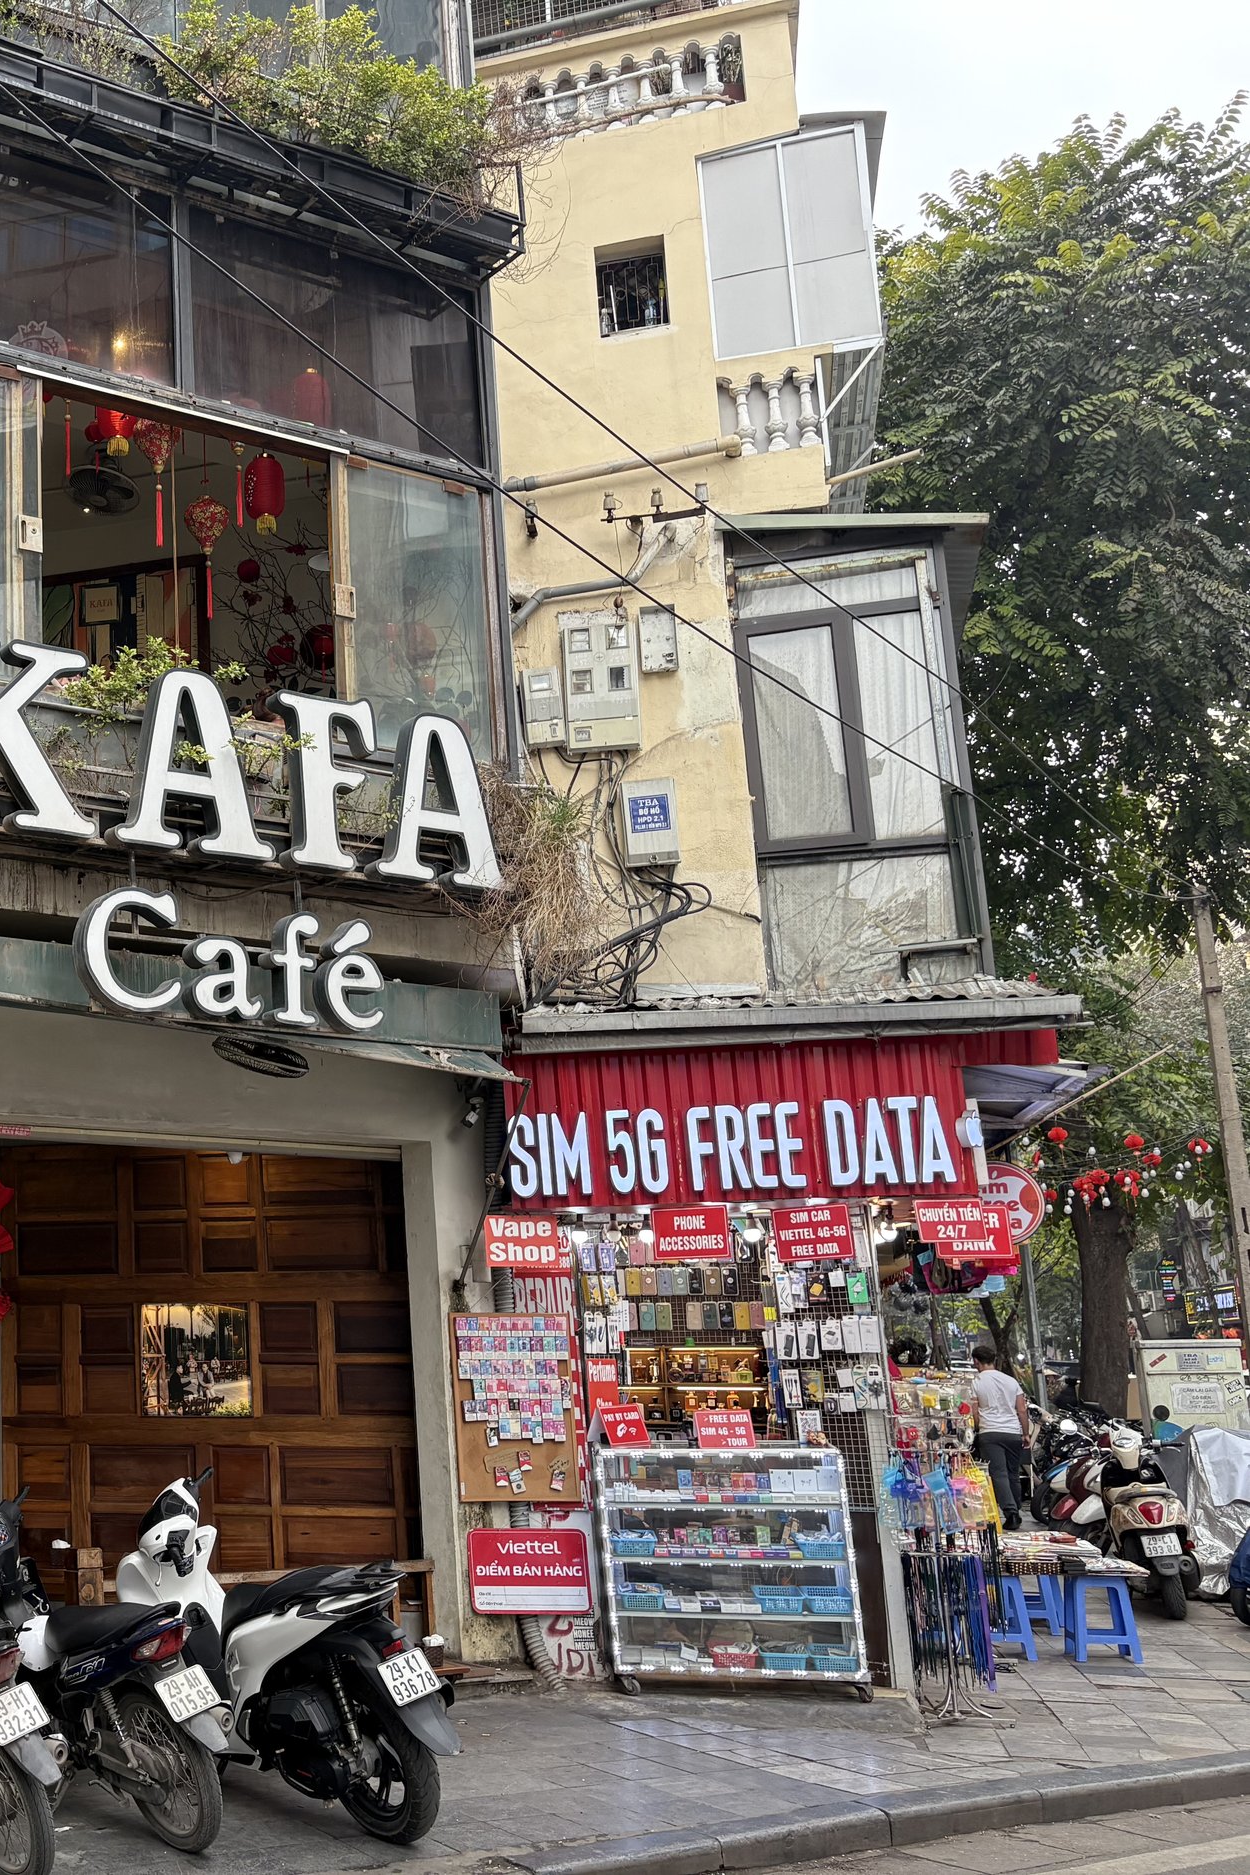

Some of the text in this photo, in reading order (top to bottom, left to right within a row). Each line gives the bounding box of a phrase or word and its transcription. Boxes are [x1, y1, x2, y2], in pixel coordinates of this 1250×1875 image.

[638, 799, 659, 807] TBA
[72, 887, 384, 1032] Café
[507, 1095, 958, 1199] SIM 5G FREE DATA
[979, 1181, 1008, 1194] im
[790, 1210, 831, 1224] SIM CAR
[919, 1203, 956, 1222] CHUYỂN
[489, 1218, 552, 1239] Vape
[674, 1215, 706, 1231] PHONE
[779, 1225, 847, 1241] VIETTEL 4G-5G
[937, 1225, 966, 1239] 24/7
[659, 1235, 725, 1252] ACCESSORIES
[791, 1243, 840, 1257] FREE DATA
[490, 1242, 556, 1264] Shop
[588, 1361, 616, 1382] Perfume
[603, 1413, 615, 1422] PAY
[624, 1411, 640, 1420] CARD
[709, 1414, 749, 1423] FREE DATA
[701, 1427, 716, 1436] SIM
[718, 1427, 728, 1435] 4G
[735, 1426, 746, 1435] 5G
[727, 1437, 748, 1446] TOUR
[497, 1540, 562, 1555] viettel
[476, 1560, 582, 1577] ĐIỂM BÁN HÀNG
[574, 1617, 594, 1626] MEOW
[575, 1641, 595, 1650] MEOW
[386, 1654, 422, 1682] 29-K1
[163, 1670, 202, 1699] 29-AH
[393, 1671, 436, 1701] 936.78
[171, 1686, 216, 1718] 015.95
